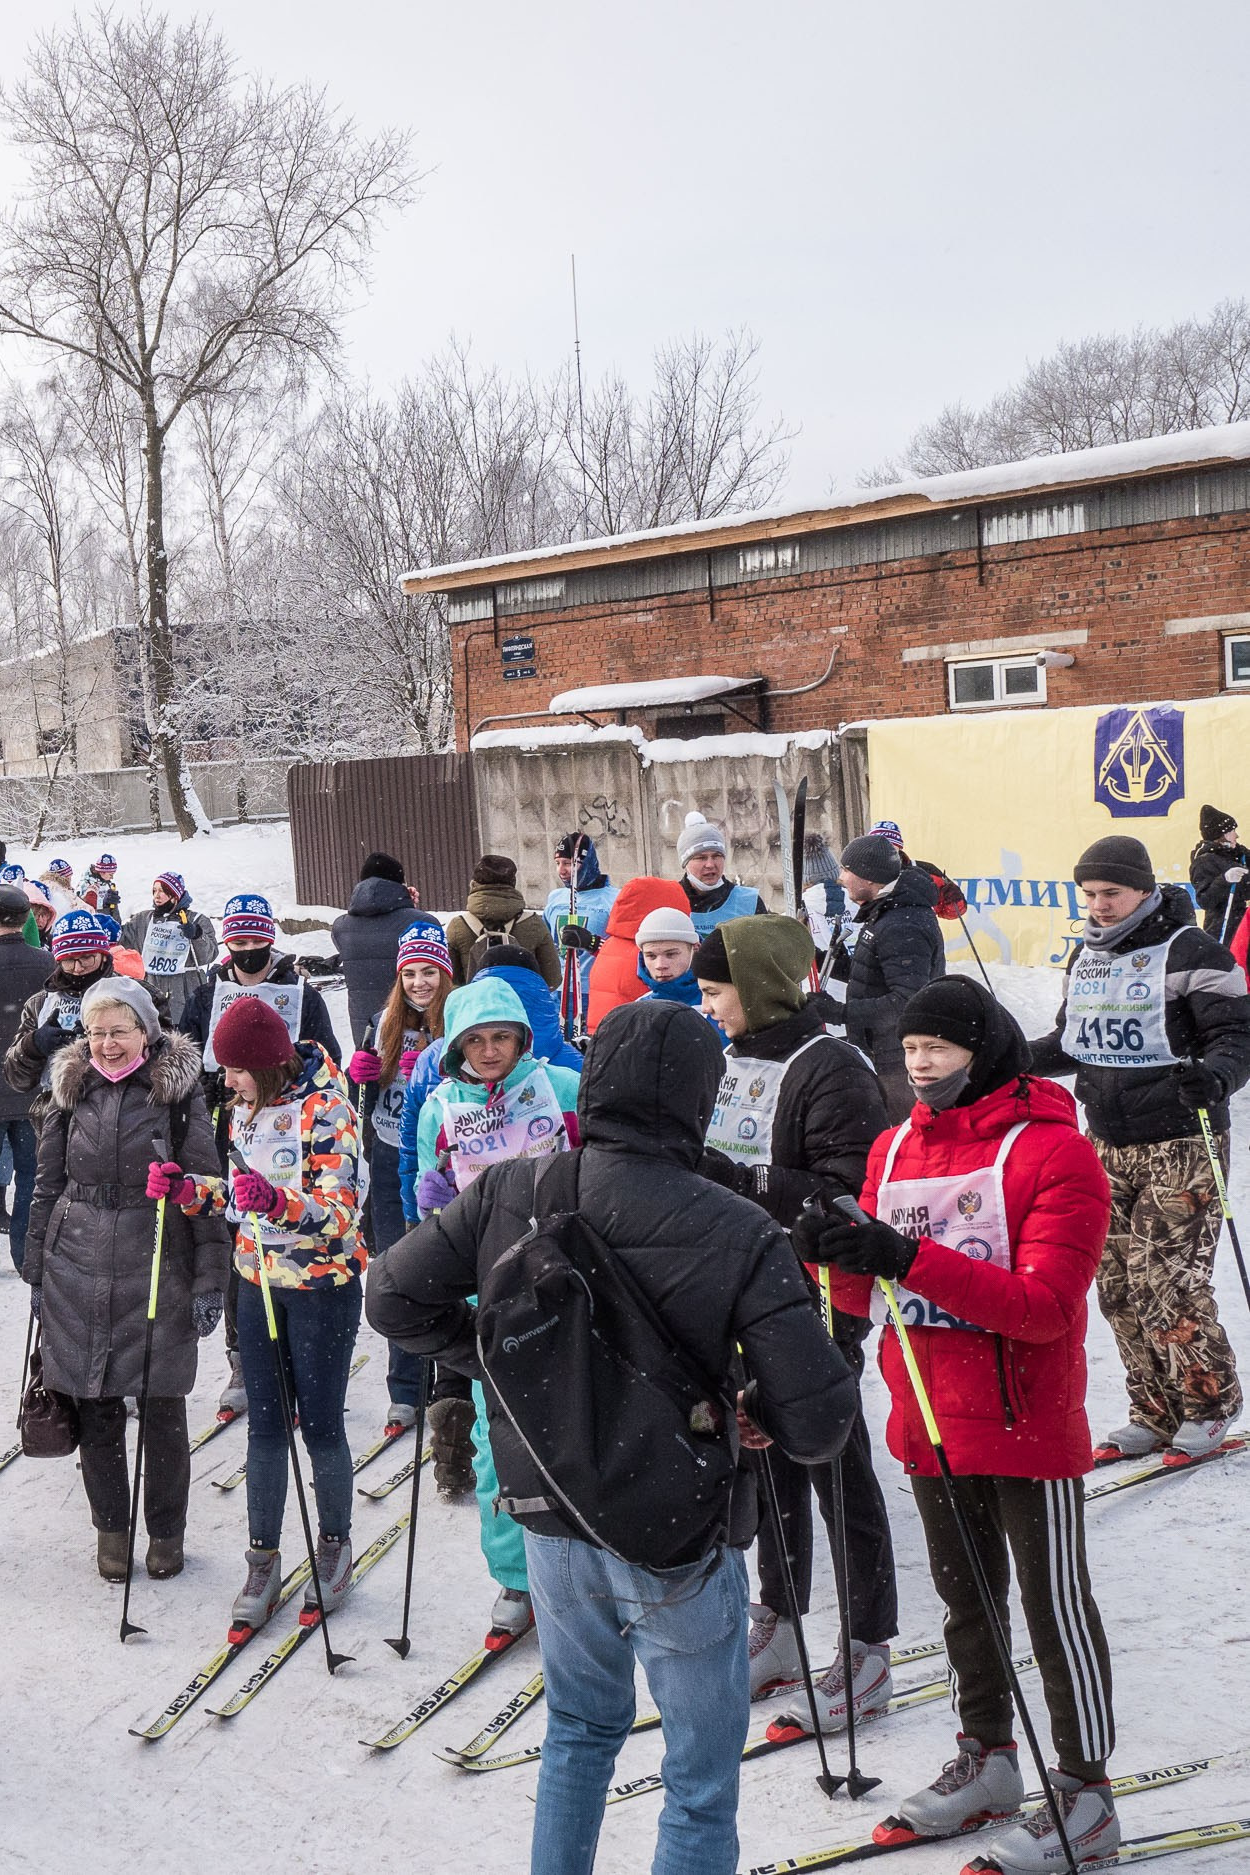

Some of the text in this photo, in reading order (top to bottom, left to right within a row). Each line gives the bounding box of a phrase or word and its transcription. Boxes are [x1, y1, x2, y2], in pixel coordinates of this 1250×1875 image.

[149, 956, 178, 972] 4608
[1076, 967, 1111, 980] РОССИИ
[1073, 981, 1106, 996] 2021
[1076, 1017, 1144, 1051] 4156
[454, 1104, 505, 1127] ЛЫЖНЯ
[459, 1133, 507, 1156] 2021
[405, 1678, 460, 1723] Larsen
[484, 1690, 533, 1734] Larsen
[1135, 1760, 1211, 1783] ACTIVE
